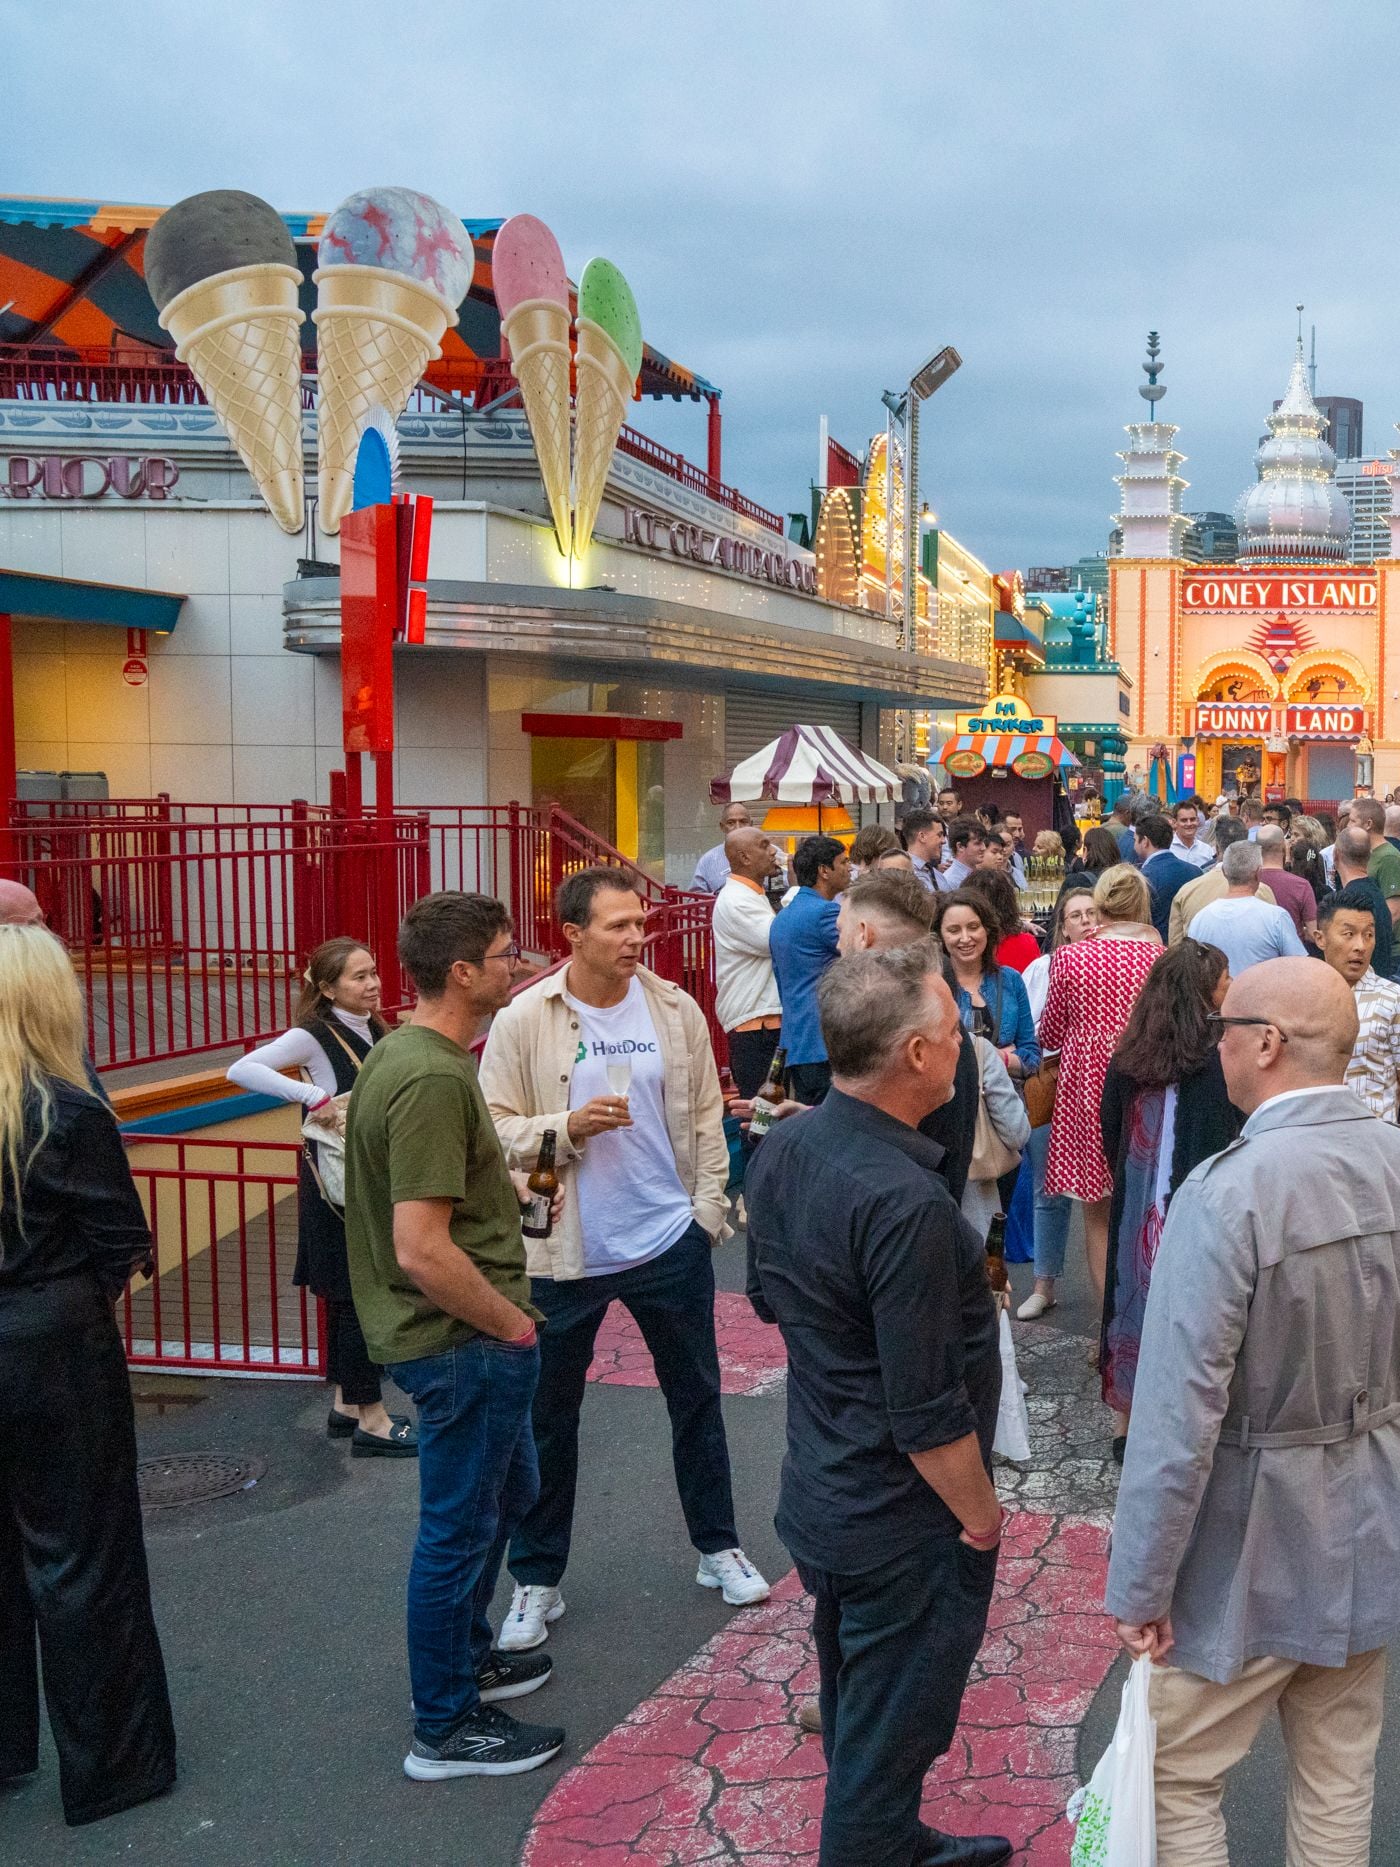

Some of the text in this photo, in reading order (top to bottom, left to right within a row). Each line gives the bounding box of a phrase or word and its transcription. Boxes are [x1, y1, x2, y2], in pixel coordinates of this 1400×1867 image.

[0, 455, 180, 499] RLOUR
[1362, 460, 1393, 477] FUJITSU
[625, 505, 667, 551] ICE
[1186, 582, 1377, 607] CONEY ISLAND
[995, 701, 1016, 716] HI
[967, 717, 1044, 734] STRIKER
[1198, 709, 1355, 733] FUNNY LAND
[592, 1040, 656, 1056] HotDoc
